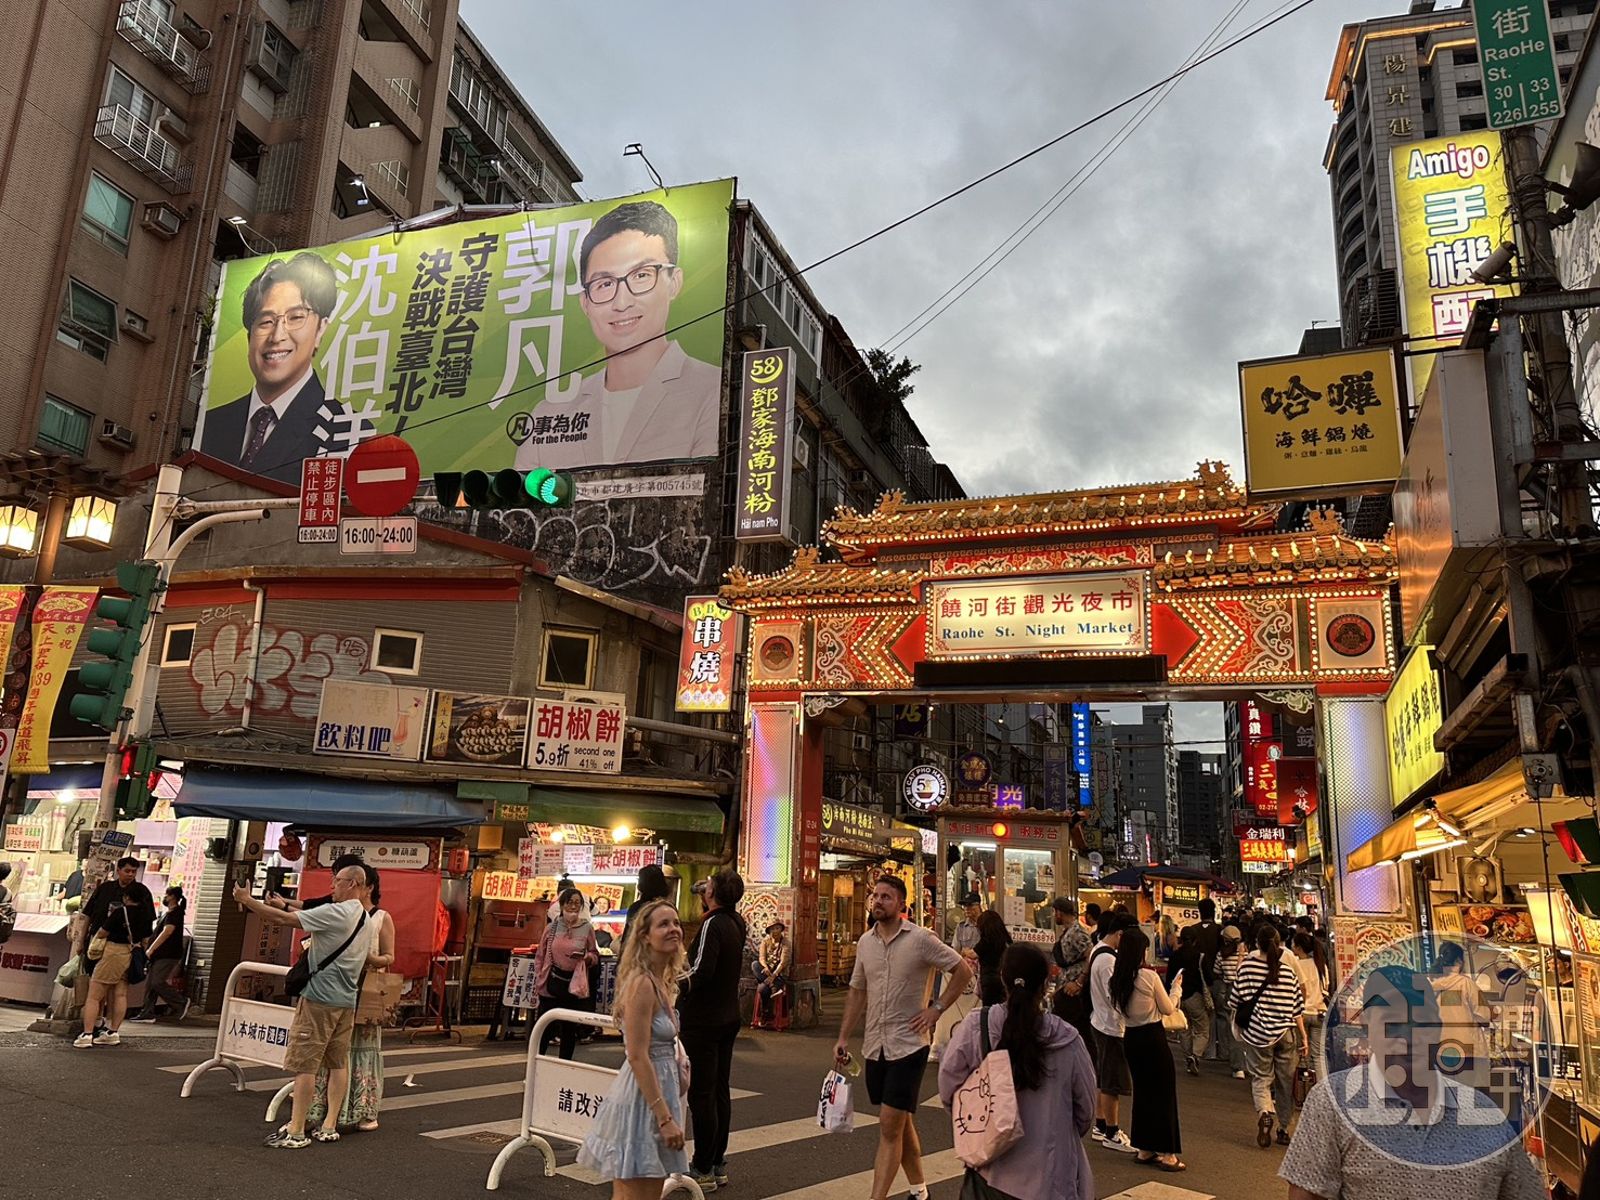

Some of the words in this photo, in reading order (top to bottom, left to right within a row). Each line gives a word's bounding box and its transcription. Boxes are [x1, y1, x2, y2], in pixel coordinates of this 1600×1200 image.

[1492, 5, 1532, 39] 街
[1485, 39, 1545, 63] RaoHe
[1487, 67, 1512, 82] St.
[1530, 79, 1550, 92] 33
[1494, 85, 1513, 100] 30
[1493, 108, 1522, 125] 226
[1530, 101, 1559, 117] 255
[1408, 143, 1490, 180] Amigo
[428, 232, 499, 399] 守護台灣
[487, 214, 592, 411] 郭凡
[384, 247, 453, 436] 決戰臺北
[312, 251, 397, 458] 沈伯洋
[750, 356, 776, 376] 58
[532, 435, 544, 445] For
[546, 434, 559, 444] the
[560, 431, 588, 443] People
[1275, 423, 1374, 448] 海鮮鍋燒
[744, 387, 779, 514] 鄧家海南河粉
[303, 460, 321, 522] 禁止停車
[321, 460, 338, 522] 徒步區內
[345, 526, 413, 544] 16:00~24:00
[941, 589, 1134, 619] 饒河街觀光夜市
[942, 628, 985, 640] Raohe
[995, 626, 1015, 638] St.
[1026, 623, 1066, 637] Night
[1077, 621, 1133, 635] Market
[690, 616, 722, 684] 串燒
[537, 703, 621, 743] 胡椒餅
[318, 721, 392, 753] 飲料吧
[535, 742, 570, 767] 5.9折
[574, 747, 600, 756] second
[602, 749, 616, 757] one
[579, 758, 598, 769] 41%
[603, 760, 615, 769] off
[1246, 827, 1285, 840] 金瑞利
[612, 848, 657, 867] 胡椒餅
[485, 874, 529, 899] 胡椒餅
[229, 1019, 290, 1047] 人本城市漫步
